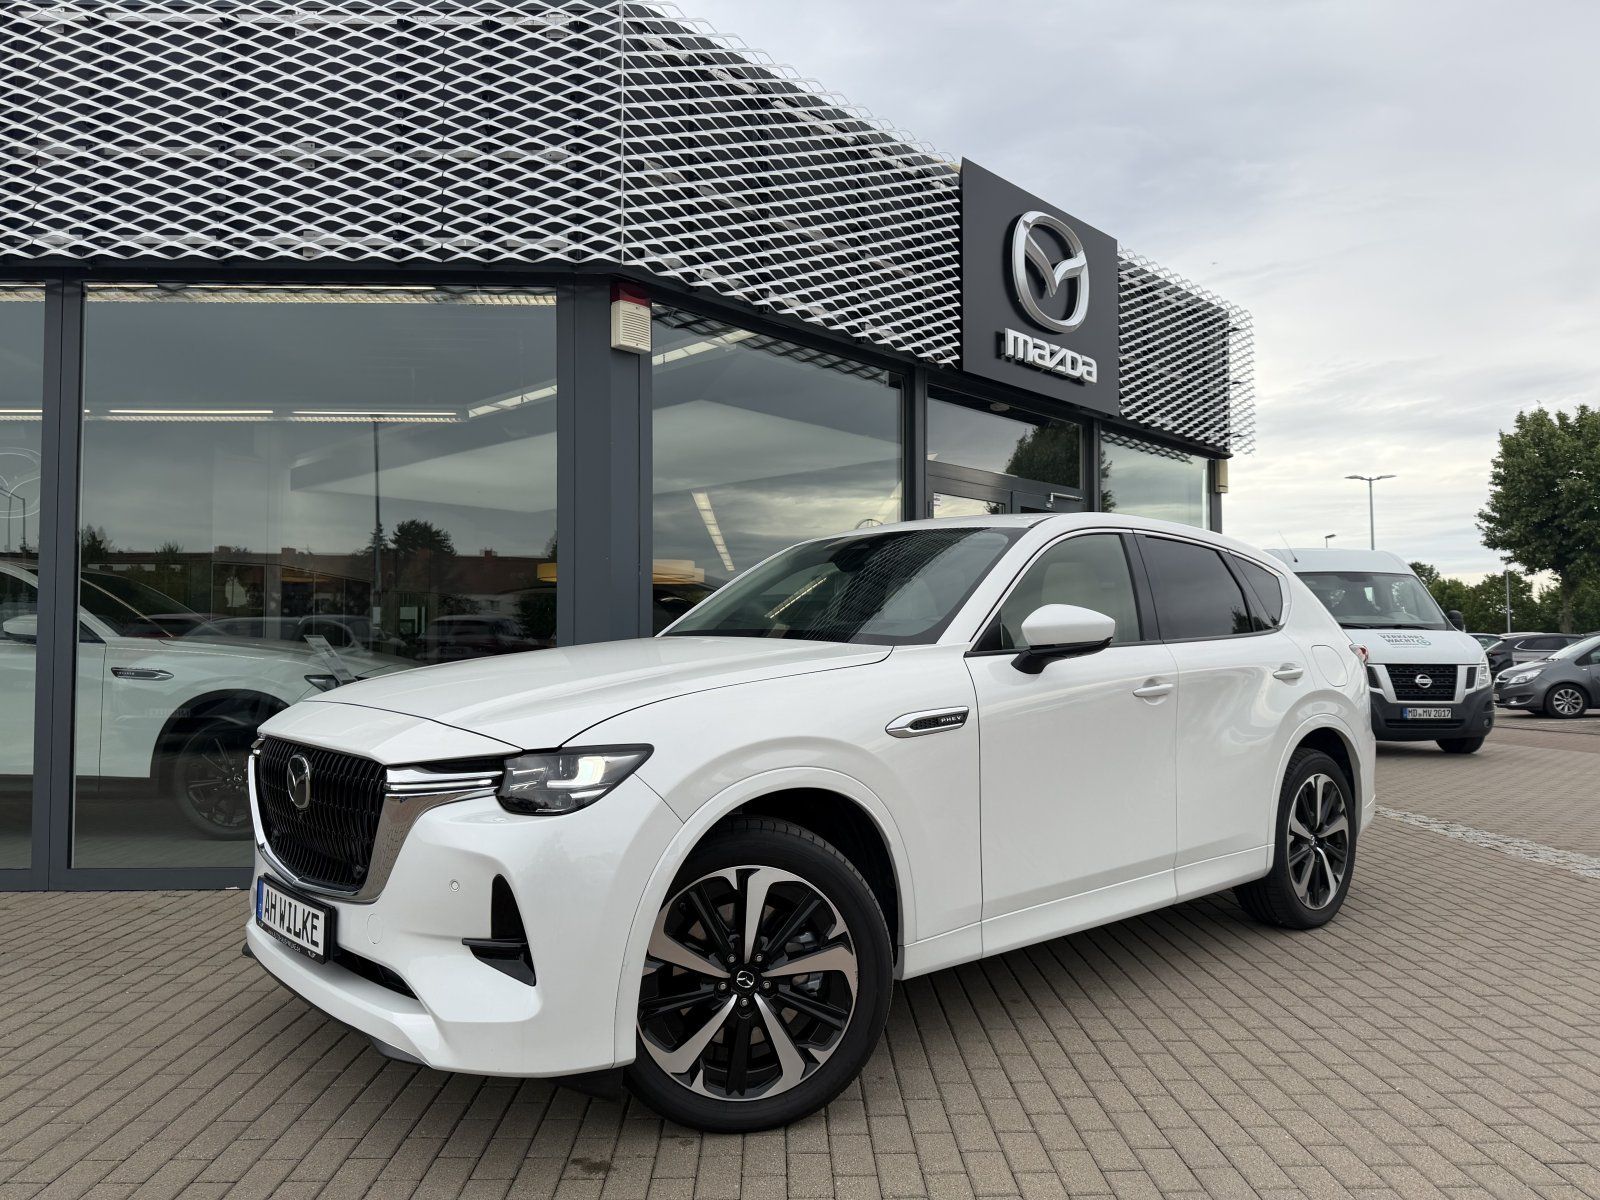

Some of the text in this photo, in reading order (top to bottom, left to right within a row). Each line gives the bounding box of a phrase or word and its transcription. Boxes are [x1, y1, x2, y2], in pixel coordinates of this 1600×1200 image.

[1408, 709, 1417, 718] MD
[1433, 709, 1450, 718] 2017
[941, 715, 961, 723] PHEV
[264, 888, 277, 925] AH
[279, 896, 319, 949] WILKE
